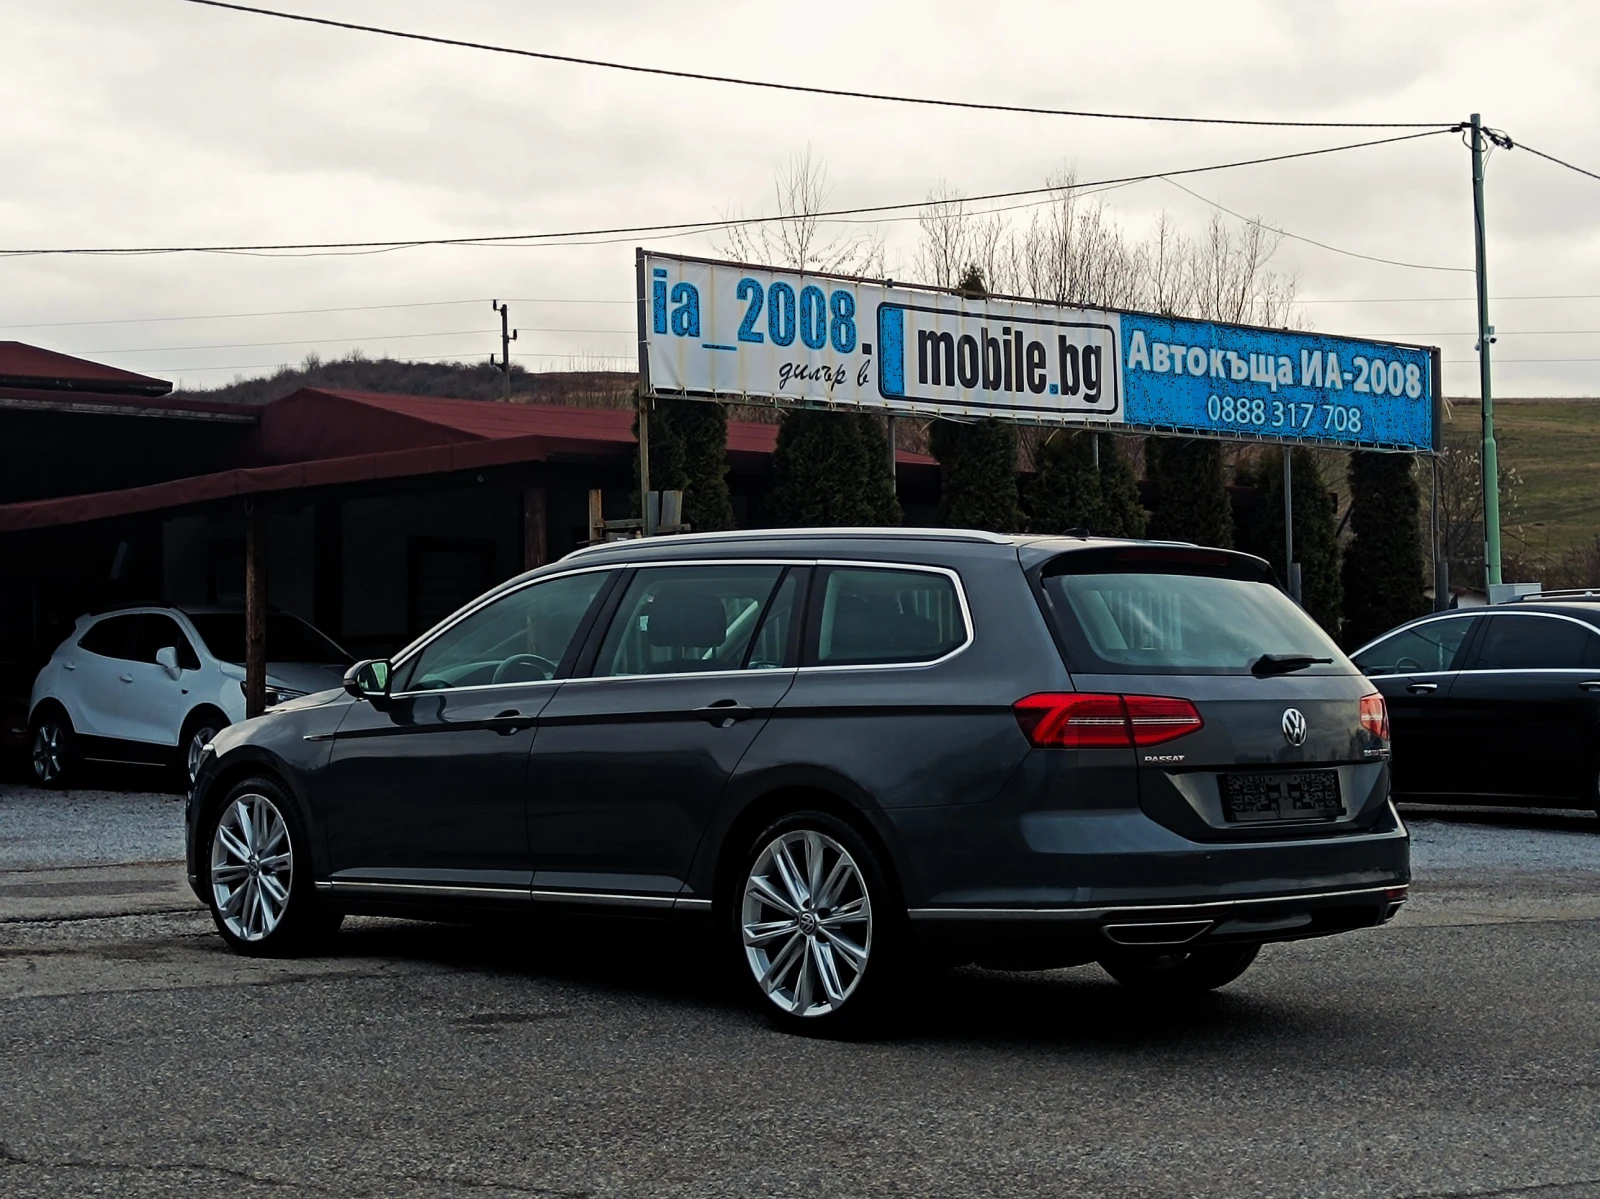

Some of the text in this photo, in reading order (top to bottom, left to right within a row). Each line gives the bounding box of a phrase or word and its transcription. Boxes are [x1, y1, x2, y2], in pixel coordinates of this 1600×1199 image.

[779, 362, 847, 392] дилър
[918, 327, 1102, 403] mobile.bg
[1127, 330, 1421, 399] Автокъща ИА-2008
[1208, 395, 1362, 433] 0888 317 708
